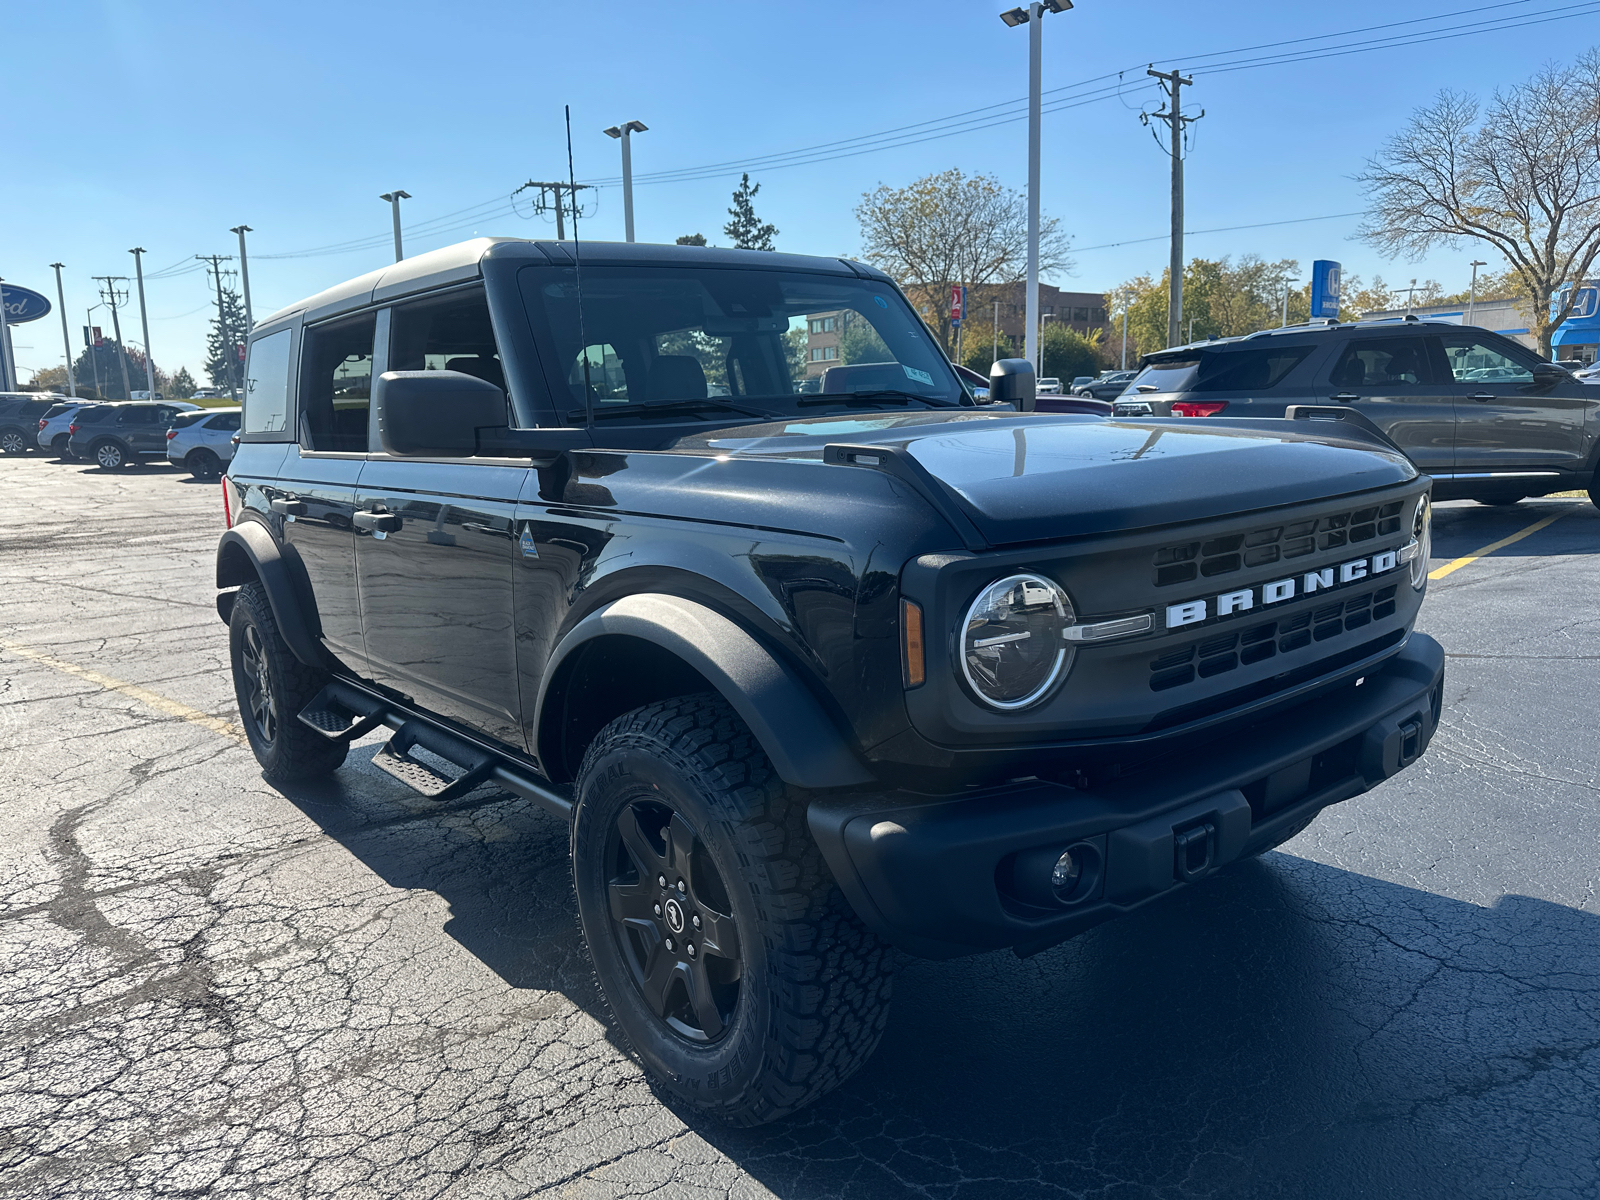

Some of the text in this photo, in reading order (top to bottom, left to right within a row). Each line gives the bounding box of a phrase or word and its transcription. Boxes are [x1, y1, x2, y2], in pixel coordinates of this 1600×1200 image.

[0, 292, 28, 315] rd
[1165, 551, 1397, 629] BRONCO
[576, 760, 632, 860] GENERAL
[706, 966, 759, 1090] GRABBER
